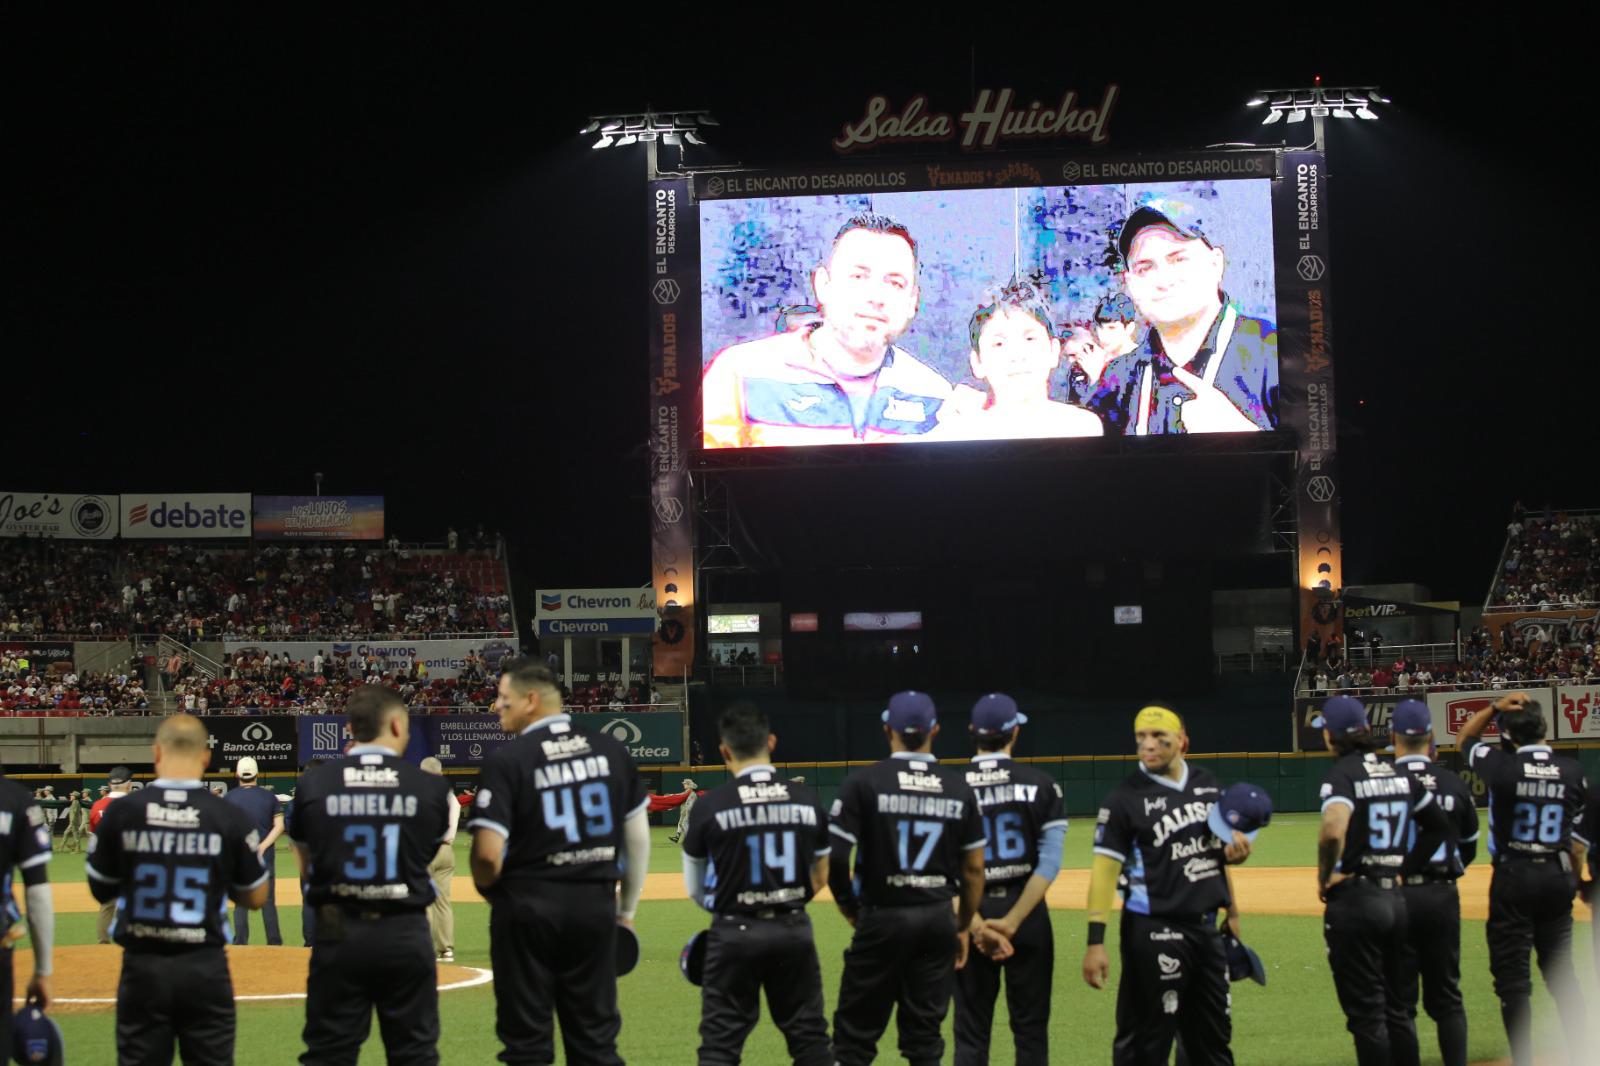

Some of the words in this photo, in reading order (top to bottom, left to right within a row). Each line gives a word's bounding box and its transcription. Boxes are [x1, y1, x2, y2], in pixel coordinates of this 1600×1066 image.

[836, 97, 951, 148] Salsa
[960, 86, 1117, 146] Huichol
[1083, 165, 1098, 178] EL
[1102, 162, 1165, 177] ENCANTO
[1168, 158, 1263, 174] DESARROLLOS
[727, 179, 742, 193] EL
[745, 176, 807, 191] ENCANTO
[812, 172, 906, 189] DESARROLLOS
[1297, 163, 1310, 230] ENCANTO
[1310, 164, 1318, 230] DESARROLLOS
[656, 189, 666, 254] ENCANTO
[667, 189, 676, 253] DESARROLLOS
[1299, 233, 1310, 250] EL
[656, 258, 667, 274] EL
[1307, 383, 1320, 450] ENCANTO
[1320, 383, 1329, 450] DESARROLLOS
[658, 406, 669, 472] ENCANTO
[1310, 452, 1320, 470] EL
[0, 494, 64, 529] Joe's
[150, 501, 246, 529] debate
[6, 524, 41, 532] OYSTER
[42, 524, 60, 532] BAR
[567, 595, 631, 609] Chevron
[549, 620, 609, 633] Chevron
[357, 645, 416, 656] Chevron
[423, 660, 466, 670] ontigo
[440, 722, 500, 730] EMBELLECEMOS
[441, 733, 447, 741] Y
[448, 733, 463, 741] LOS
[464, 733, 505, 741] LLENAMOS
[507, 733, 517, 741] D
[223, 742, 255, 752] Banco
[256, 741, 292, 751] Azteca
[343, 765, 399, 783] Brück
[534, 755, 610, 790] AMADOR
[897, 768, 942, 789] Brück
[965, 768, 1010, 784] Brück
[1523, 763, 1560, 776] Brück
[738, 782, 788, 800] Brück
[326, 794, 418, 817] ORNELAS
[541, 781, 613, 843] 49
[715, 803, 818, 831] VILLANUEVA
[878, 793, 964, 820] RODRIGUEZ
[982, 811, 1026, 861] 16
[1153, 801, 1214, 847] JALIS
[1369, 801, 1409, 849] 57
[1512, 802, 1564, 843] 28
[122, 830, 222, 856] MAYFIELD
[343, 824, 400, 880] 31
[897, 819, 944, 871] 17
[746, 831, 796, 885] 14
[133, 864, 210, 924] 25
